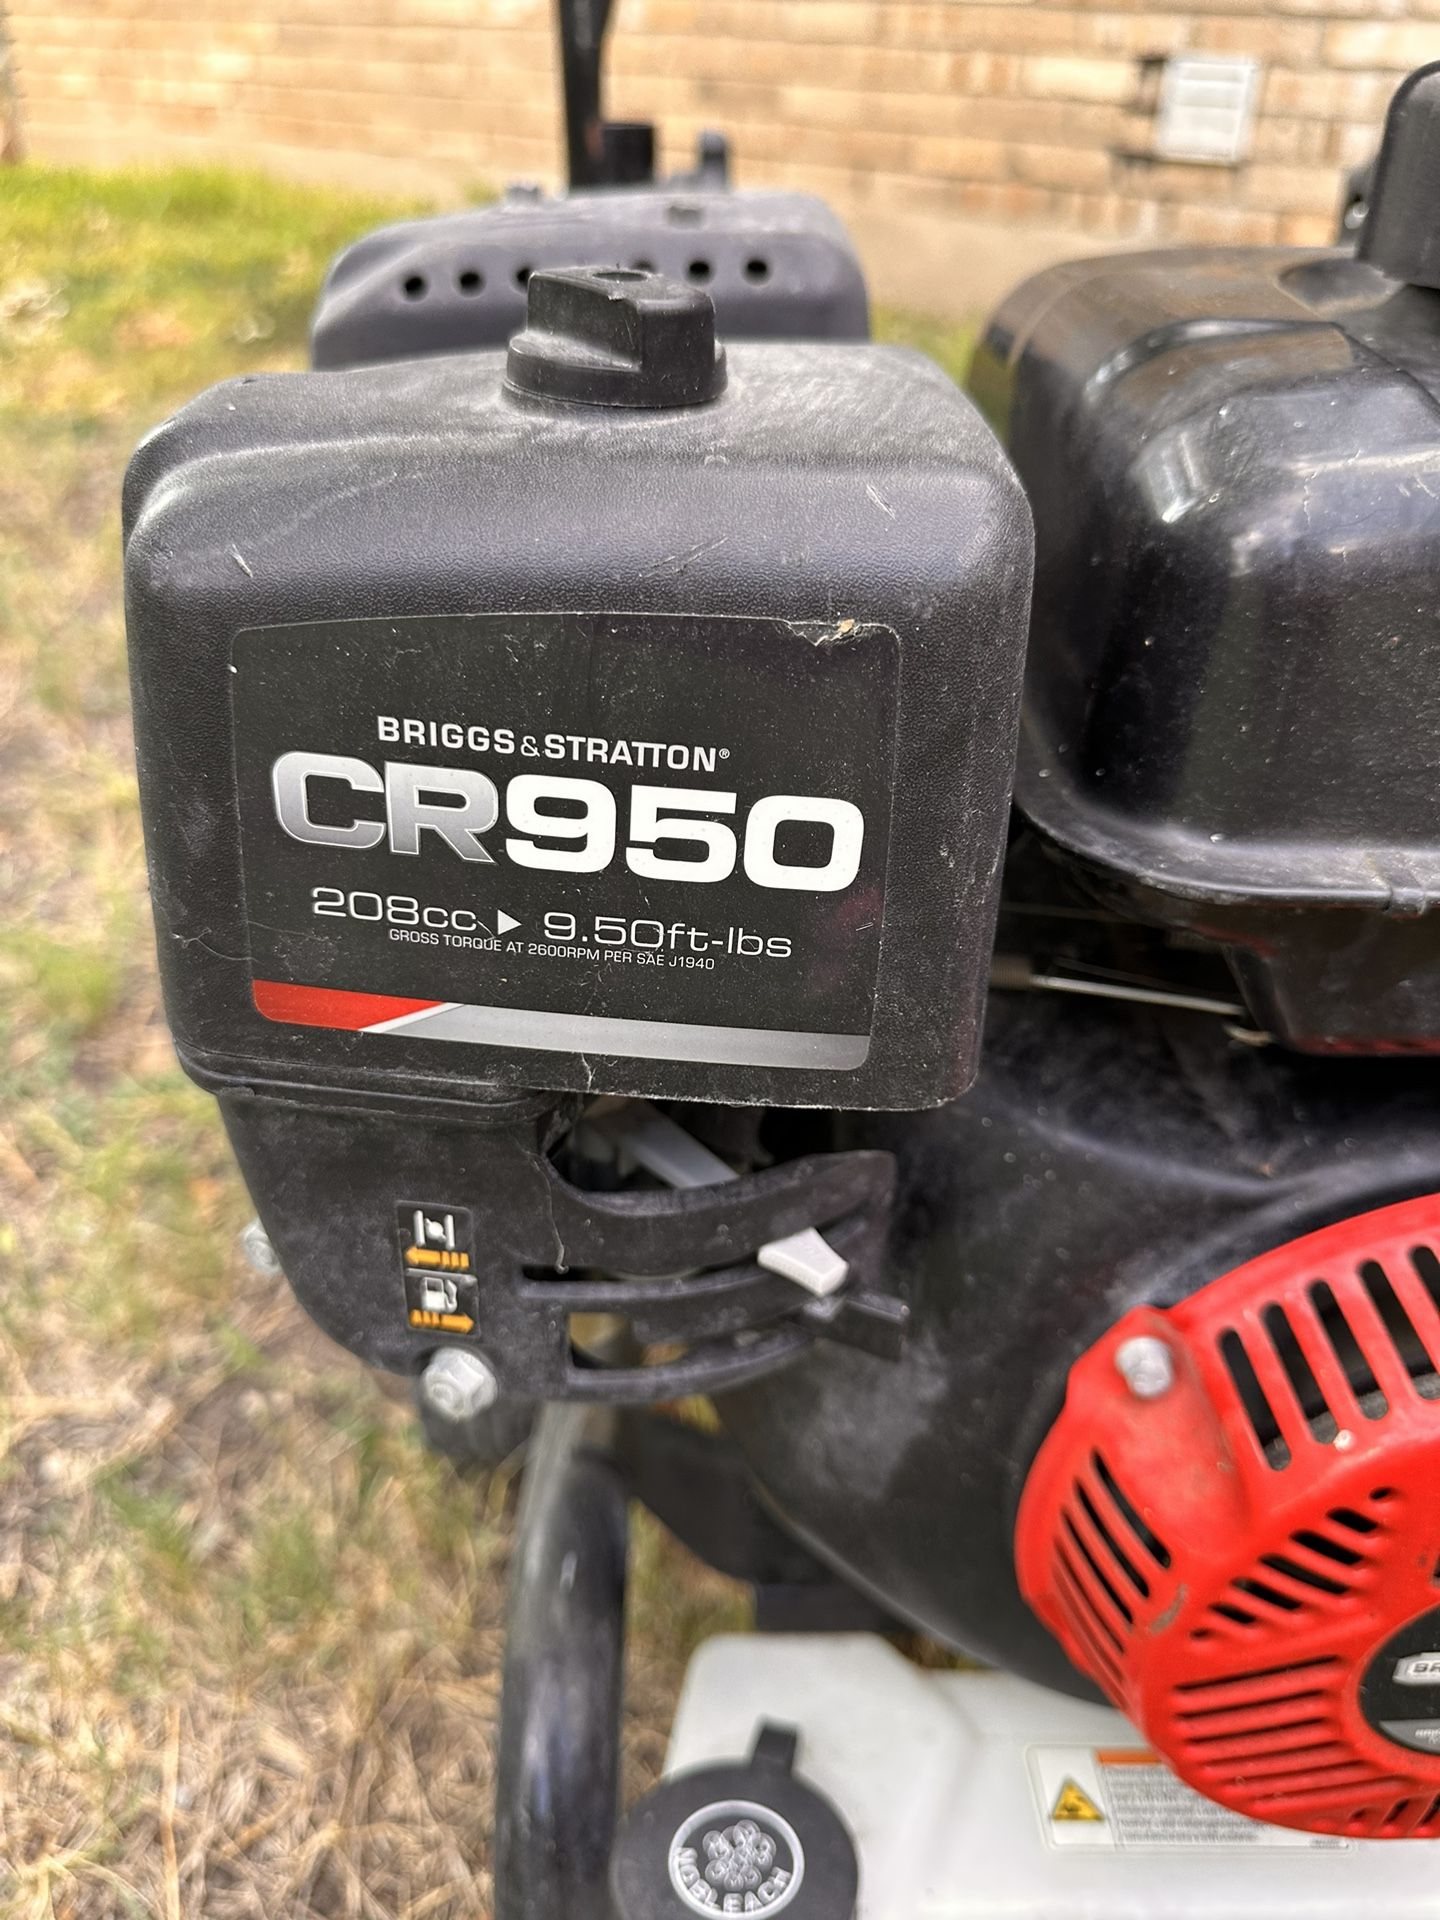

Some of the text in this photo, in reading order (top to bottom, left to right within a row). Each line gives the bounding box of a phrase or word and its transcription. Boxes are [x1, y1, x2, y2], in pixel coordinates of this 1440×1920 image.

[377, 716, 516, 755] BRIGGS
[520, 736, 541, 757] &
[272, 751, 865, 892] CR950
[312, 887, 792, 958] 208cc 9.50ft-lbs
[389, 929, 715, 970] GROSS TORQUE AT 2600RPM PER SAE J1940
